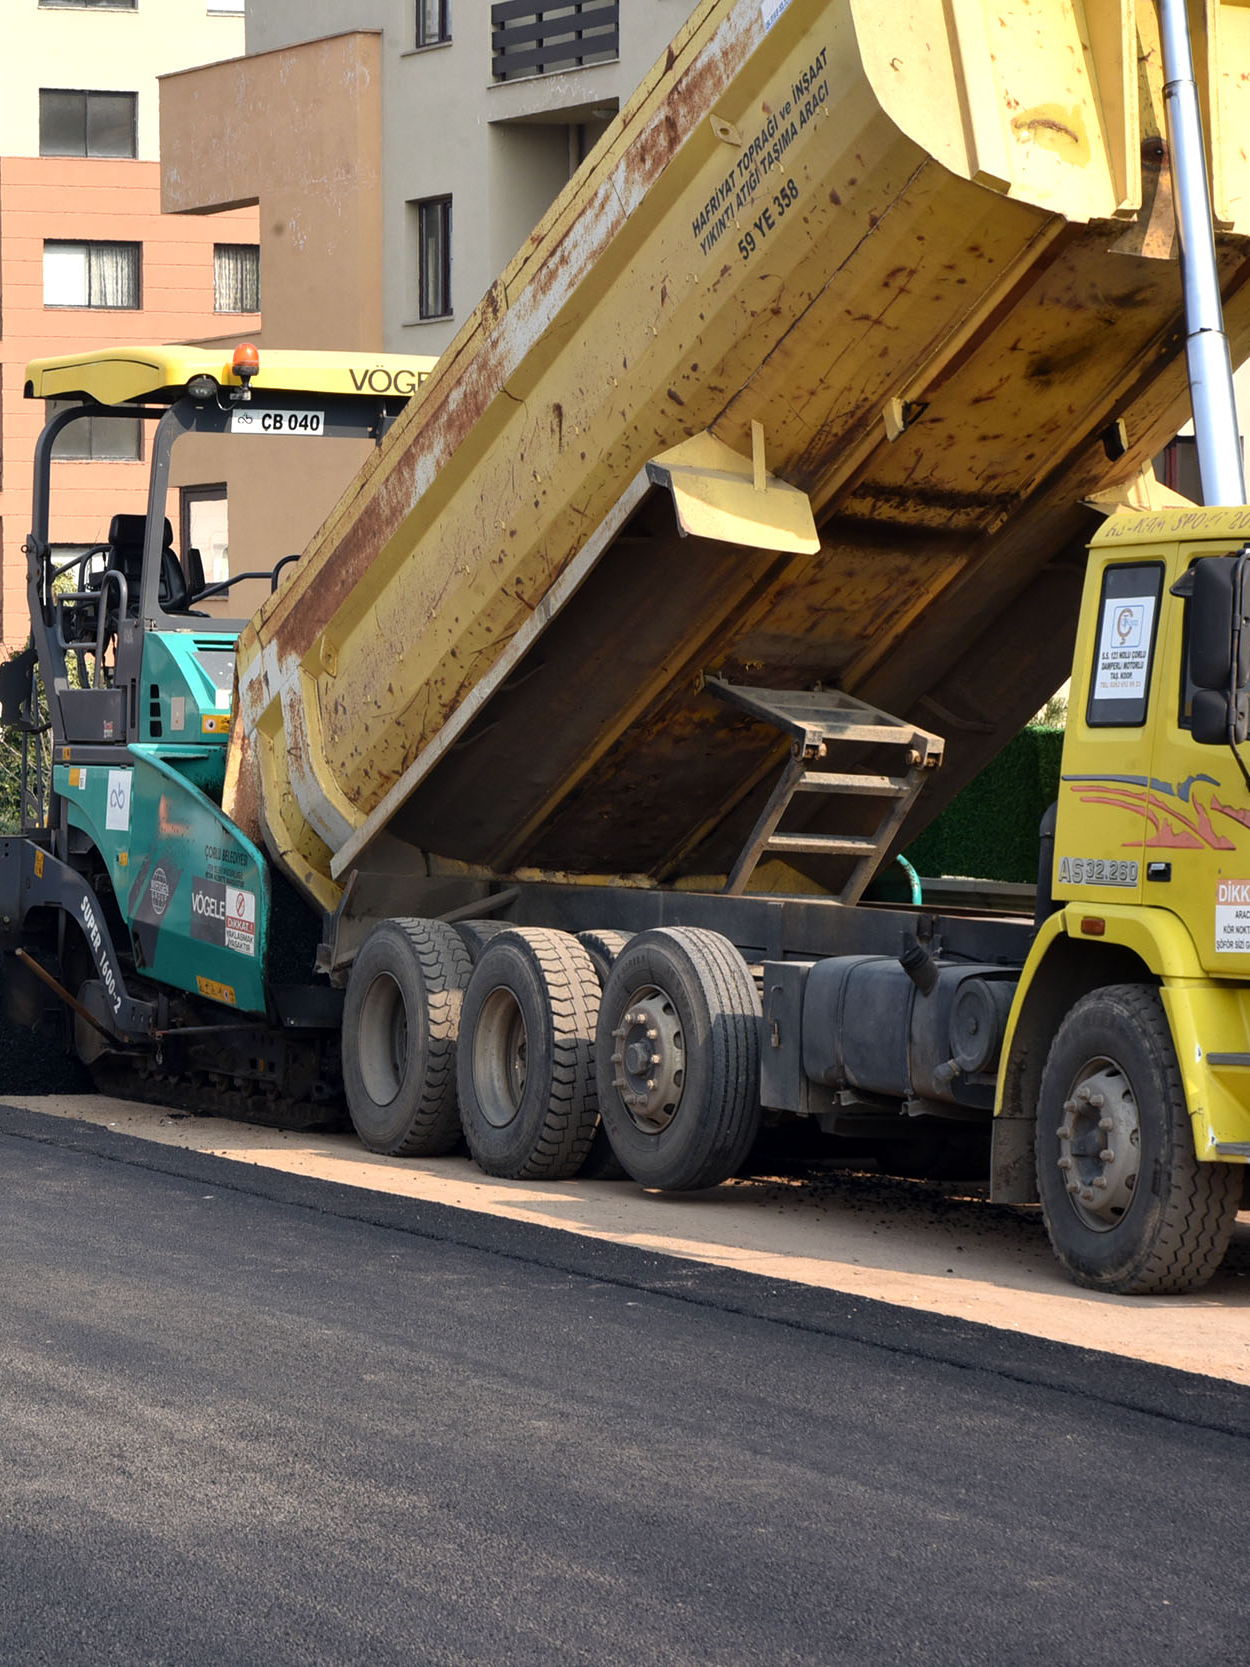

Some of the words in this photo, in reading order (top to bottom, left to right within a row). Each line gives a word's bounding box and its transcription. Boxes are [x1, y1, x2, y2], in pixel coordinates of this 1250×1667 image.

[692, 169, 735, 238] HAFRİYAT
[737, 114, 778, 178] TOPRAĞI
[780, 101, 791, 120] ve
[791, 46, 828, 104] İNŞAAT
[700, 202, 734, 256] YIKINTI
[760, 122, 798, 174] TAŞIMA
[799, 80, 829, 129] ARACI
[738, 232, 756, 260] 59
[753, 207, 775, 238] YE
[773, 178, 798, 216] 358
[261, 413, 283, 431] ÇB
[288, 414, 320, 431] 040
[81, 896, 101, 953] SUPER
[100, 950, 121, 1014] 1600-2
[192, 890, 225, 920] VÖGELE
